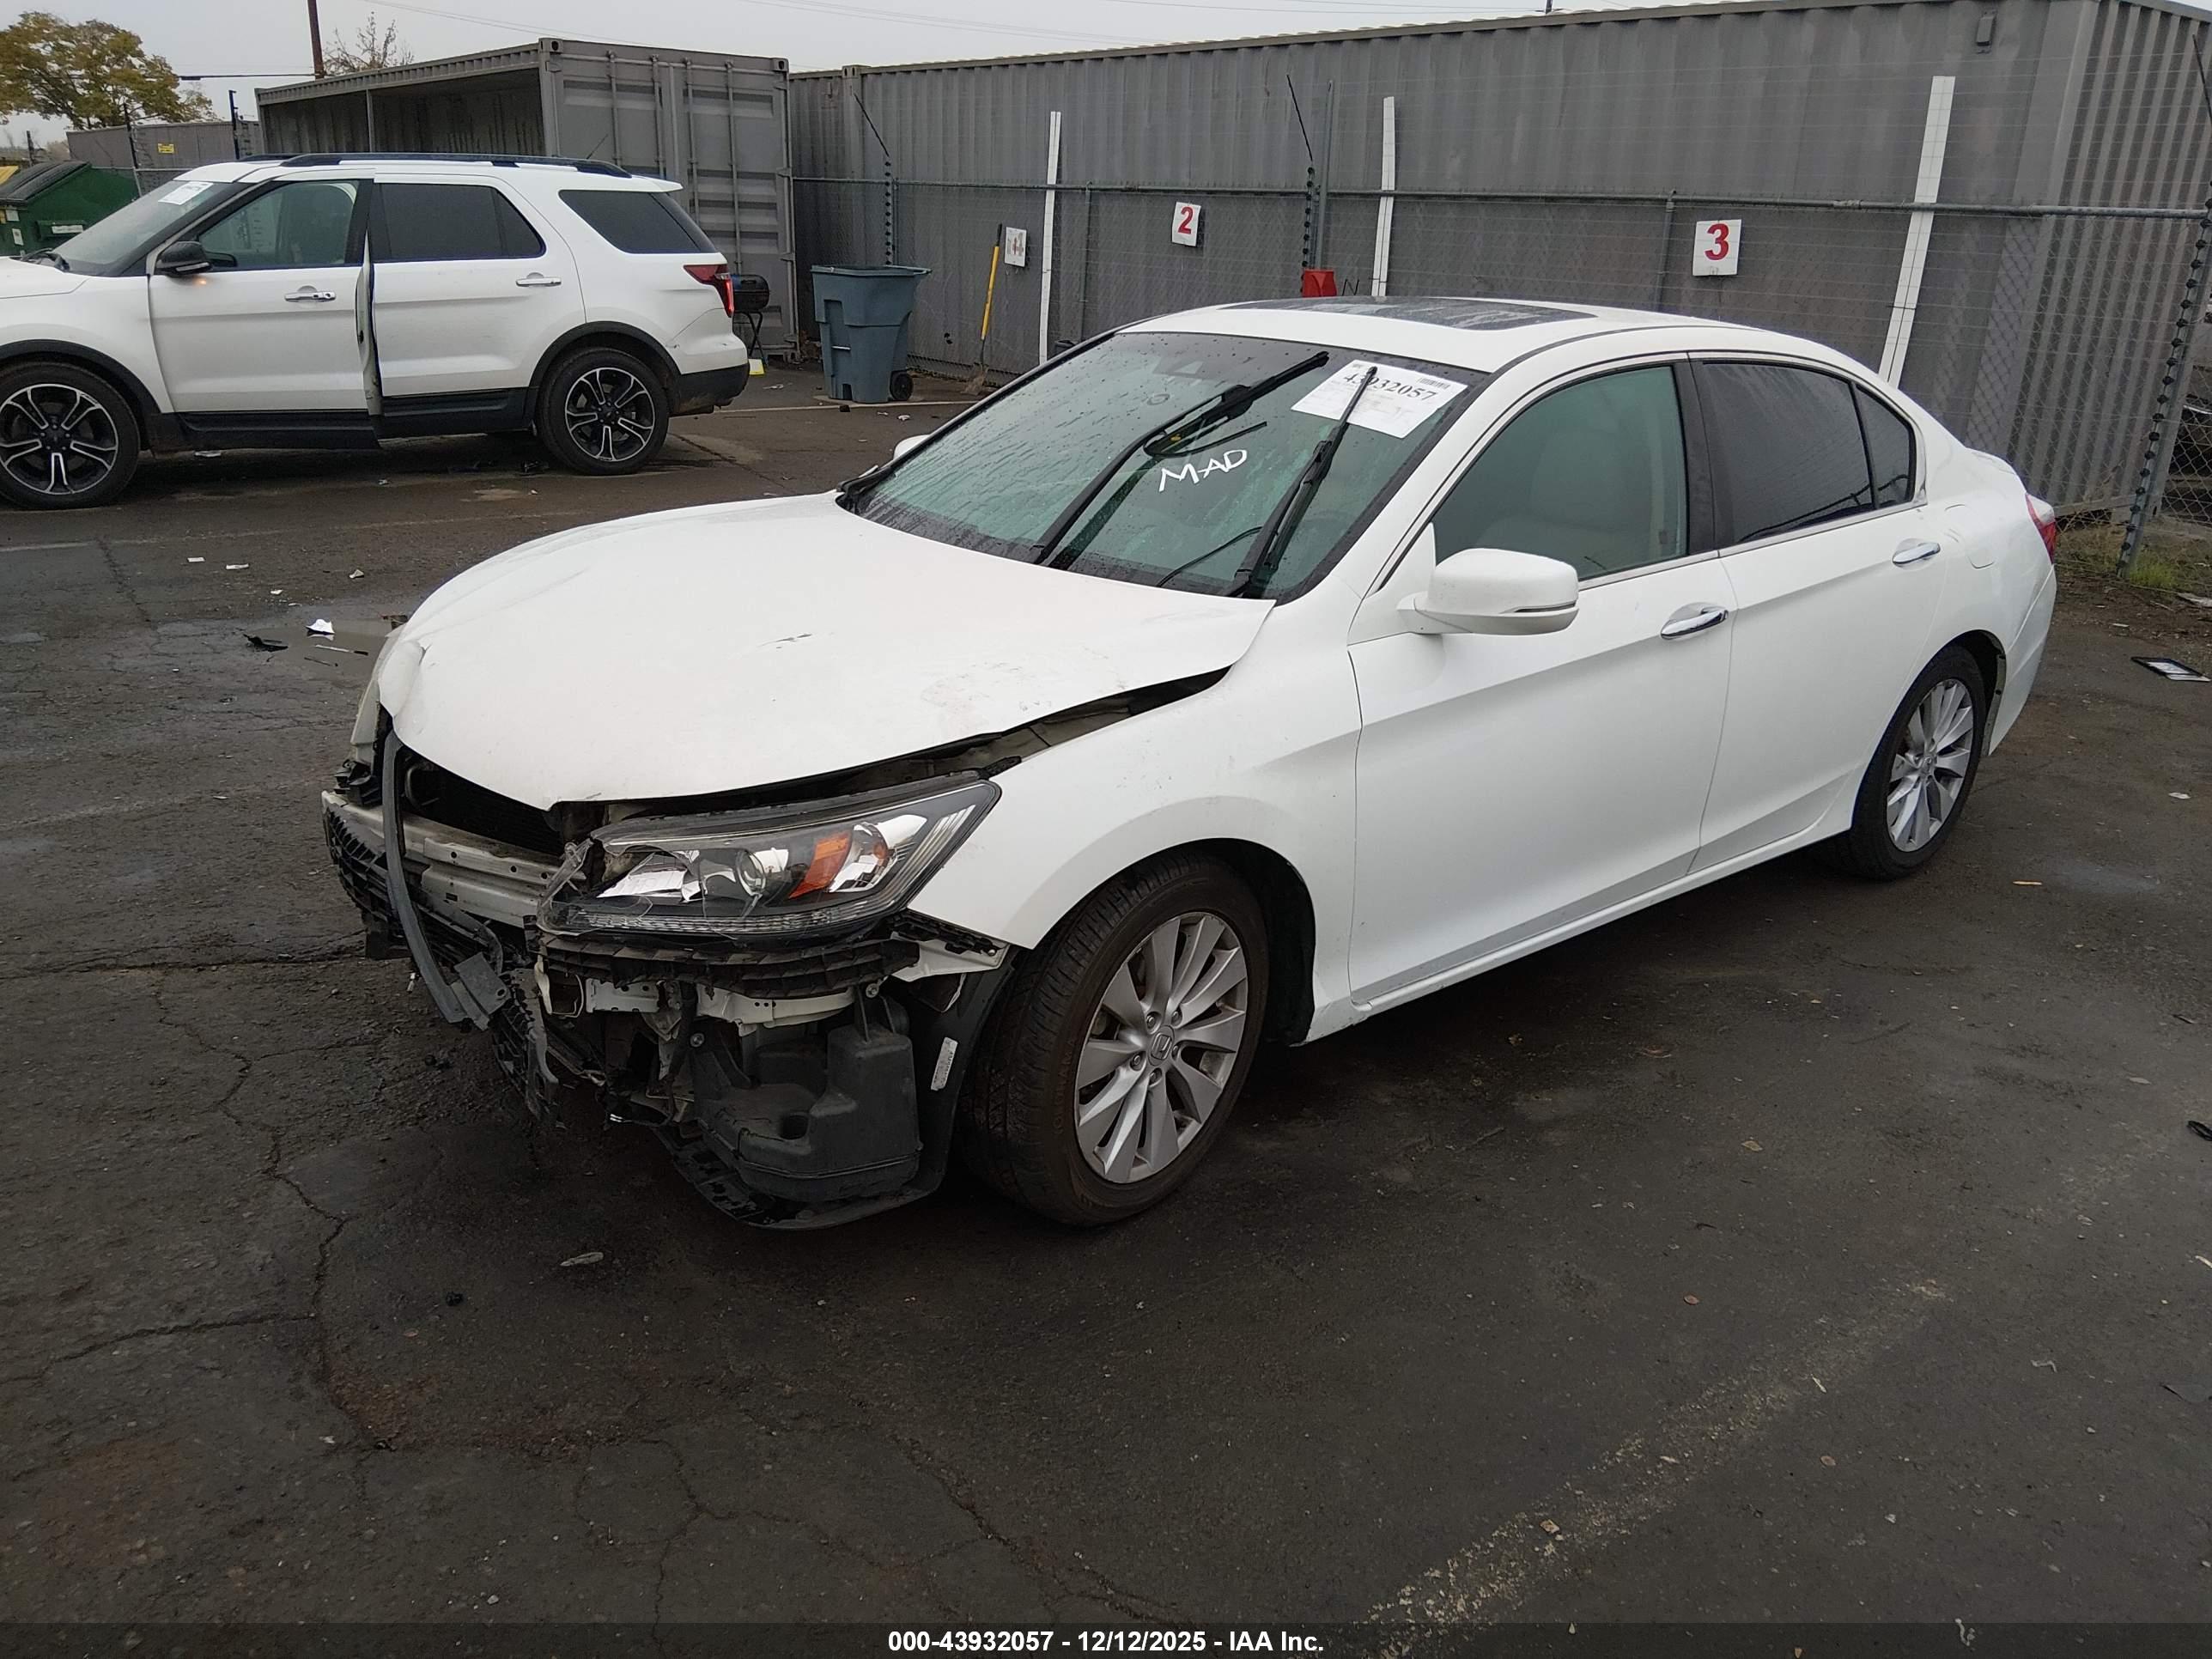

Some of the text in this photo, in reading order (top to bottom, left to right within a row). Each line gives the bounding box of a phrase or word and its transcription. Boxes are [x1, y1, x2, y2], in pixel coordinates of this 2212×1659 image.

[1178, 206, 1194, 234] 2
[1705, 223, 1729, 261] 3
[1158, 449, 1248, 493] MAD
